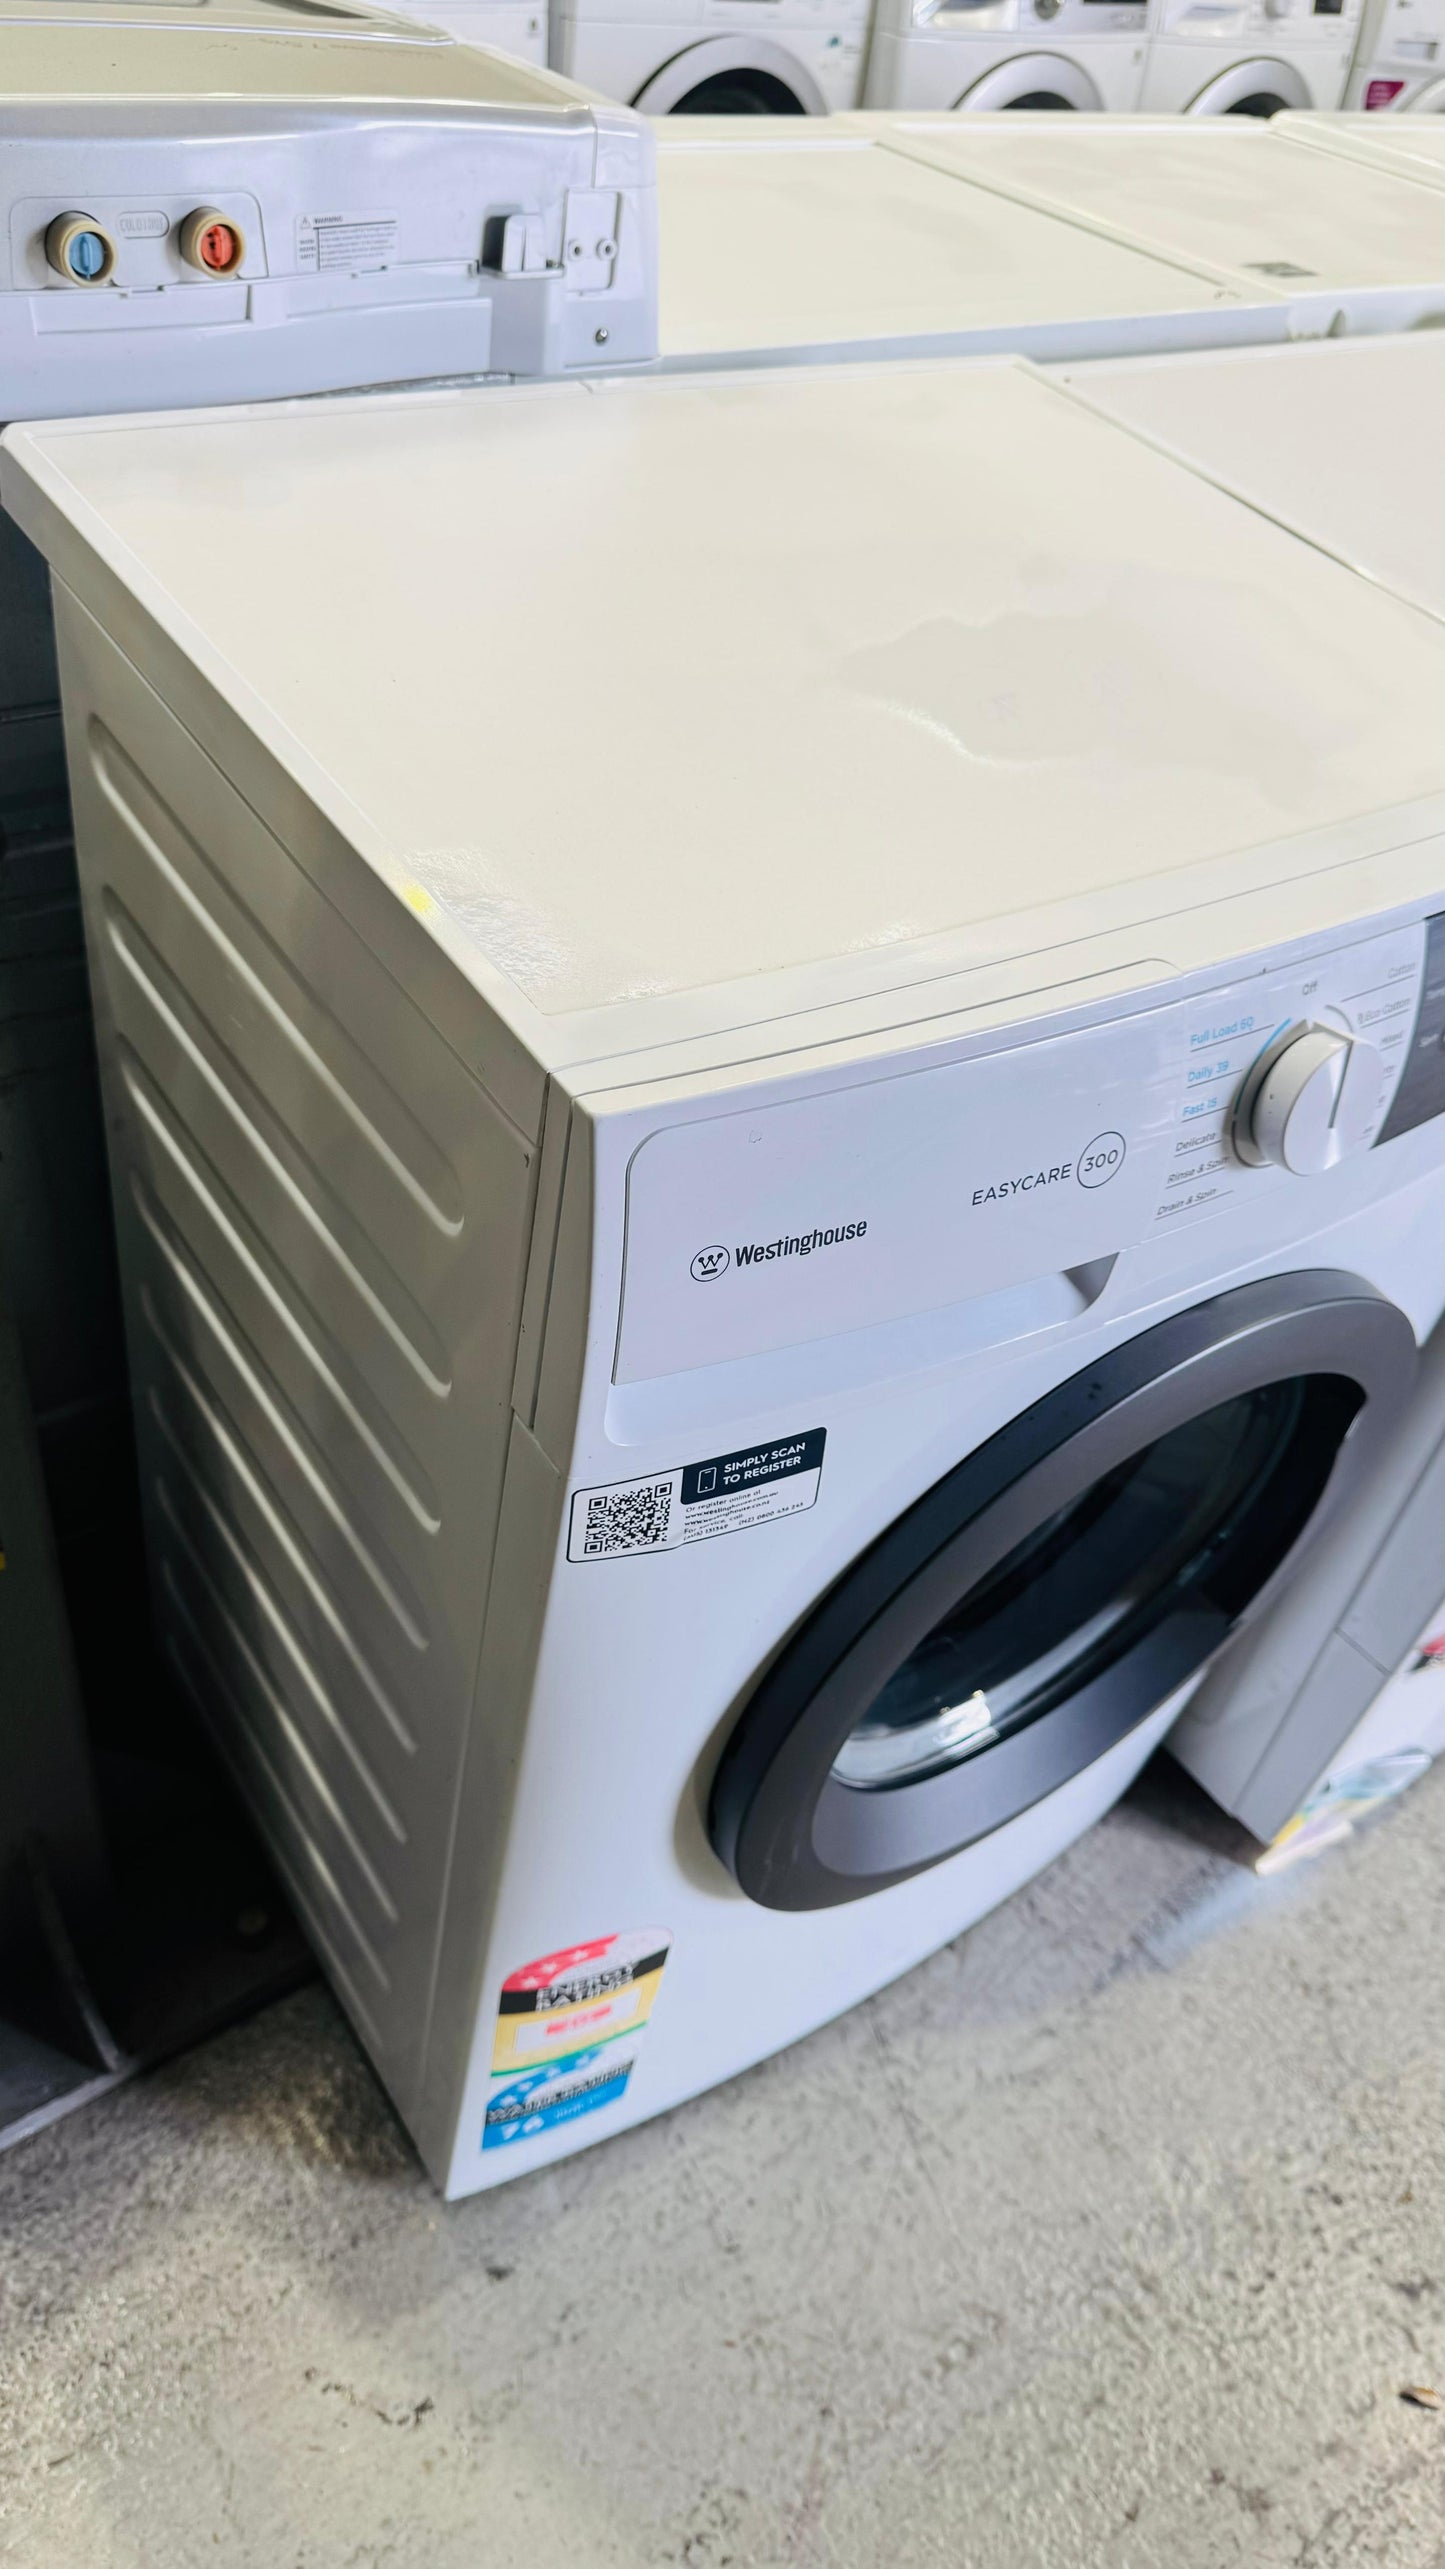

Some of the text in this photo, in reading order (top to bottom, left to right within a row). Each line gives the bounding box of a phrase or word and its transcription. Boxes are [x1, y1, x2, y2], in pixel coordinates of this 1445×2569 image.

[1190, 1030, 1210, 1046] Full
[1212, 1023, 1238, 1039] Load
[1187, 1066, 1213, 1082] Daily
[1182, 1103, 1205, 1116] Fast
[1175, 1132, 1216, 1152] Delicate
[971, 1149, 1119, 1206] EASYCARE 300
[735, 1220, 868, 1268] Westinghouse
[723, 1442, 806, 1473] SIMPLY SCAN
[723, 1456, 802, 1486] TO REGISTER
[685, 1505, 696, 1513] Or
[698, 1499, 727, 1512] register
[729, 1493, 752, 1503] online
